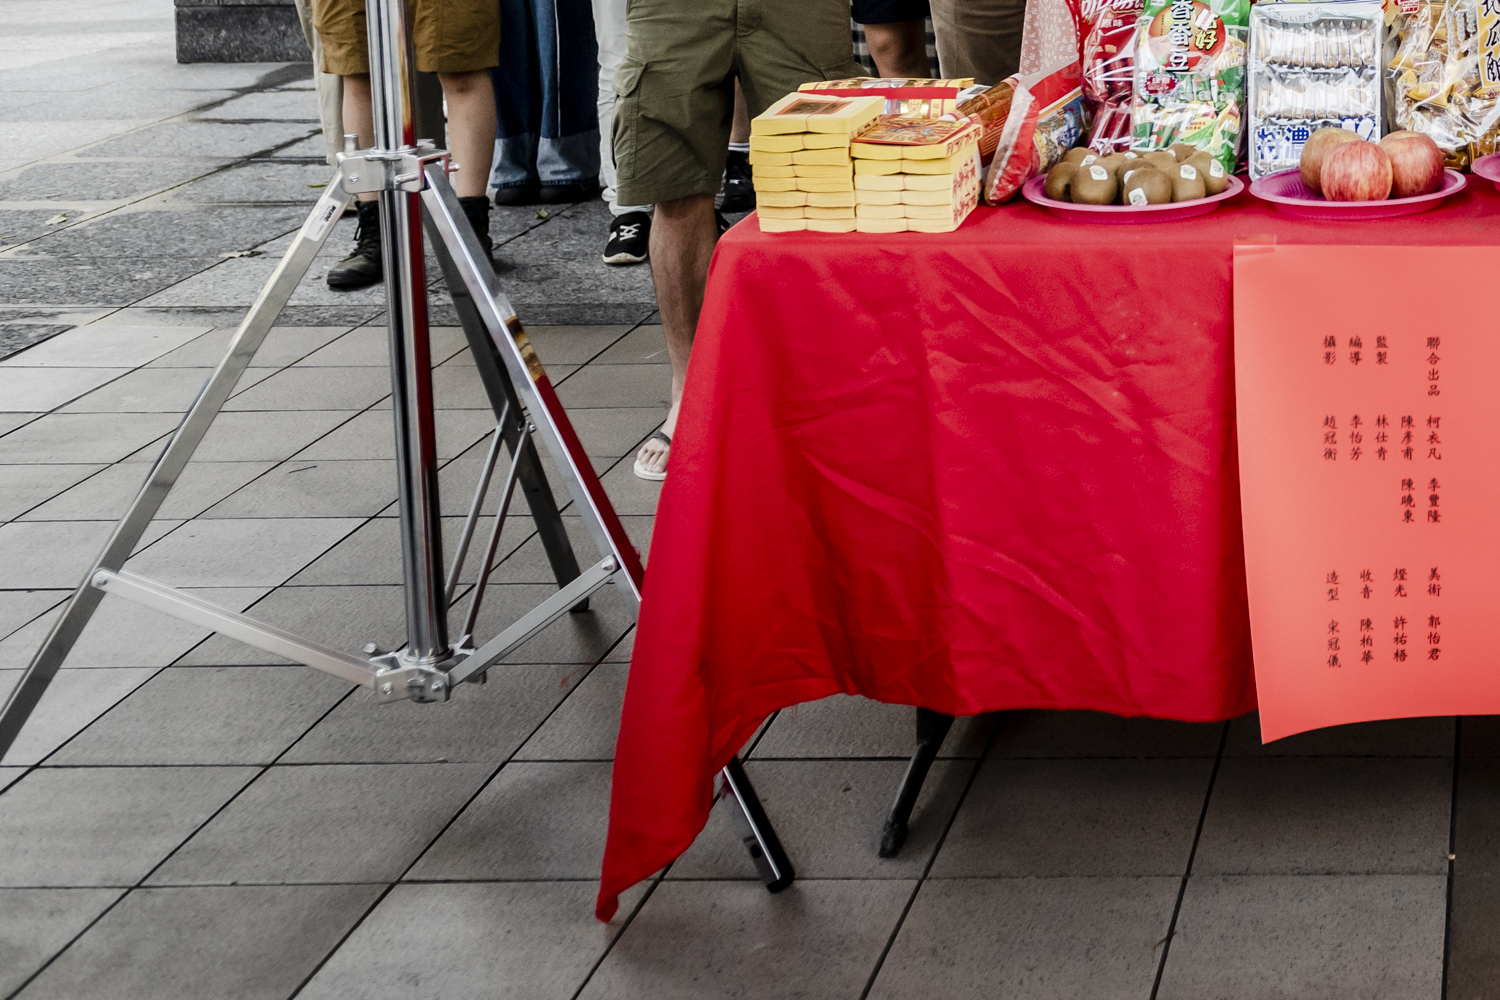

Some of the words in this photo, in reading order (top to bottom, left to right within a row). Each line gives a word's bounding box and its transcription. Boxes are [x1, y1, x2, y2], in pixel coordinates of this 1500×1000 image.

[1267, 6, 1323, 22] やさしい甘さの
[1323, 335, 1337, 365] 攝影
[1348, 335, 1363, 366] 編導
[1375, 335, 1389, 365] 監製
[1426, 335, 1441, 397] 聯合出品
[1349, 414, 1363, 461] 李怡芳
[1325, 569, 1340, 602] 造型
[1359, 568, 1374, 599] 收音
[1392, 567, 1407, 597] 燈光
[1427, 566, 1441, 597] 美術
[1427, 614, 1441, 661] 郭怡君
